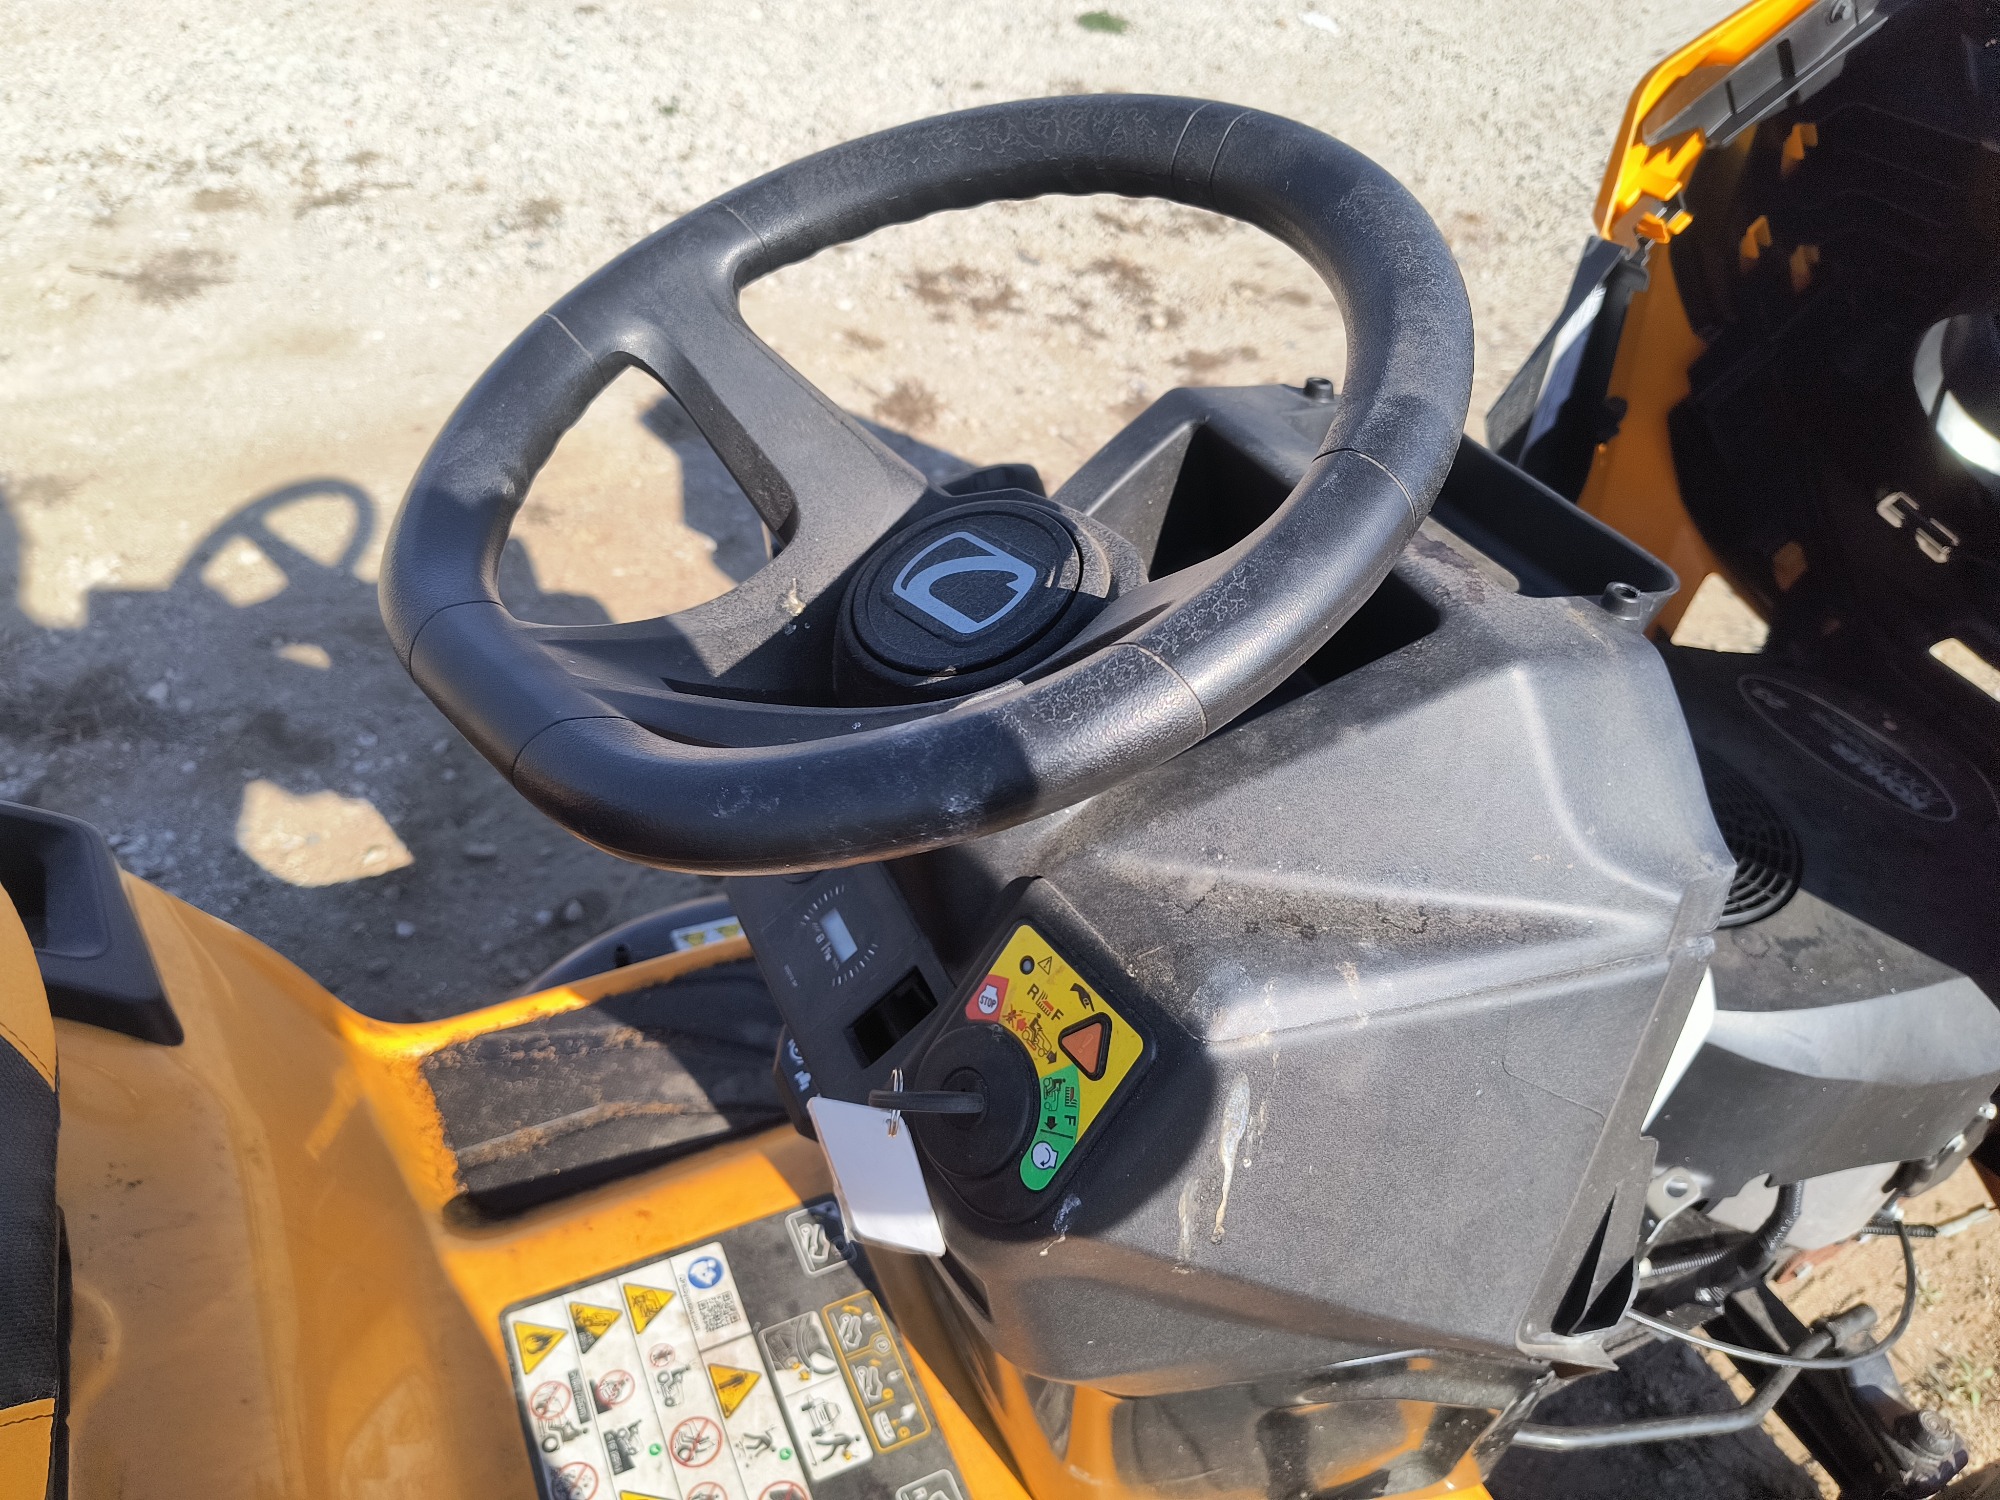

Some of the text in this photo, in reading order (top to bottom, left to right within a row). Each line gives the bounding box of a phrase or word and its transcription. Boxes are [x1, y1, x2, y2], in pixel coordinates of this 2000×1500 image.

[1027, 984, 1040, 1000] R
[980, 995, 997, 1008] STOP
[1051, 1009, 1064, 1021] F
[1064, 1115, 1076, 1126] F
